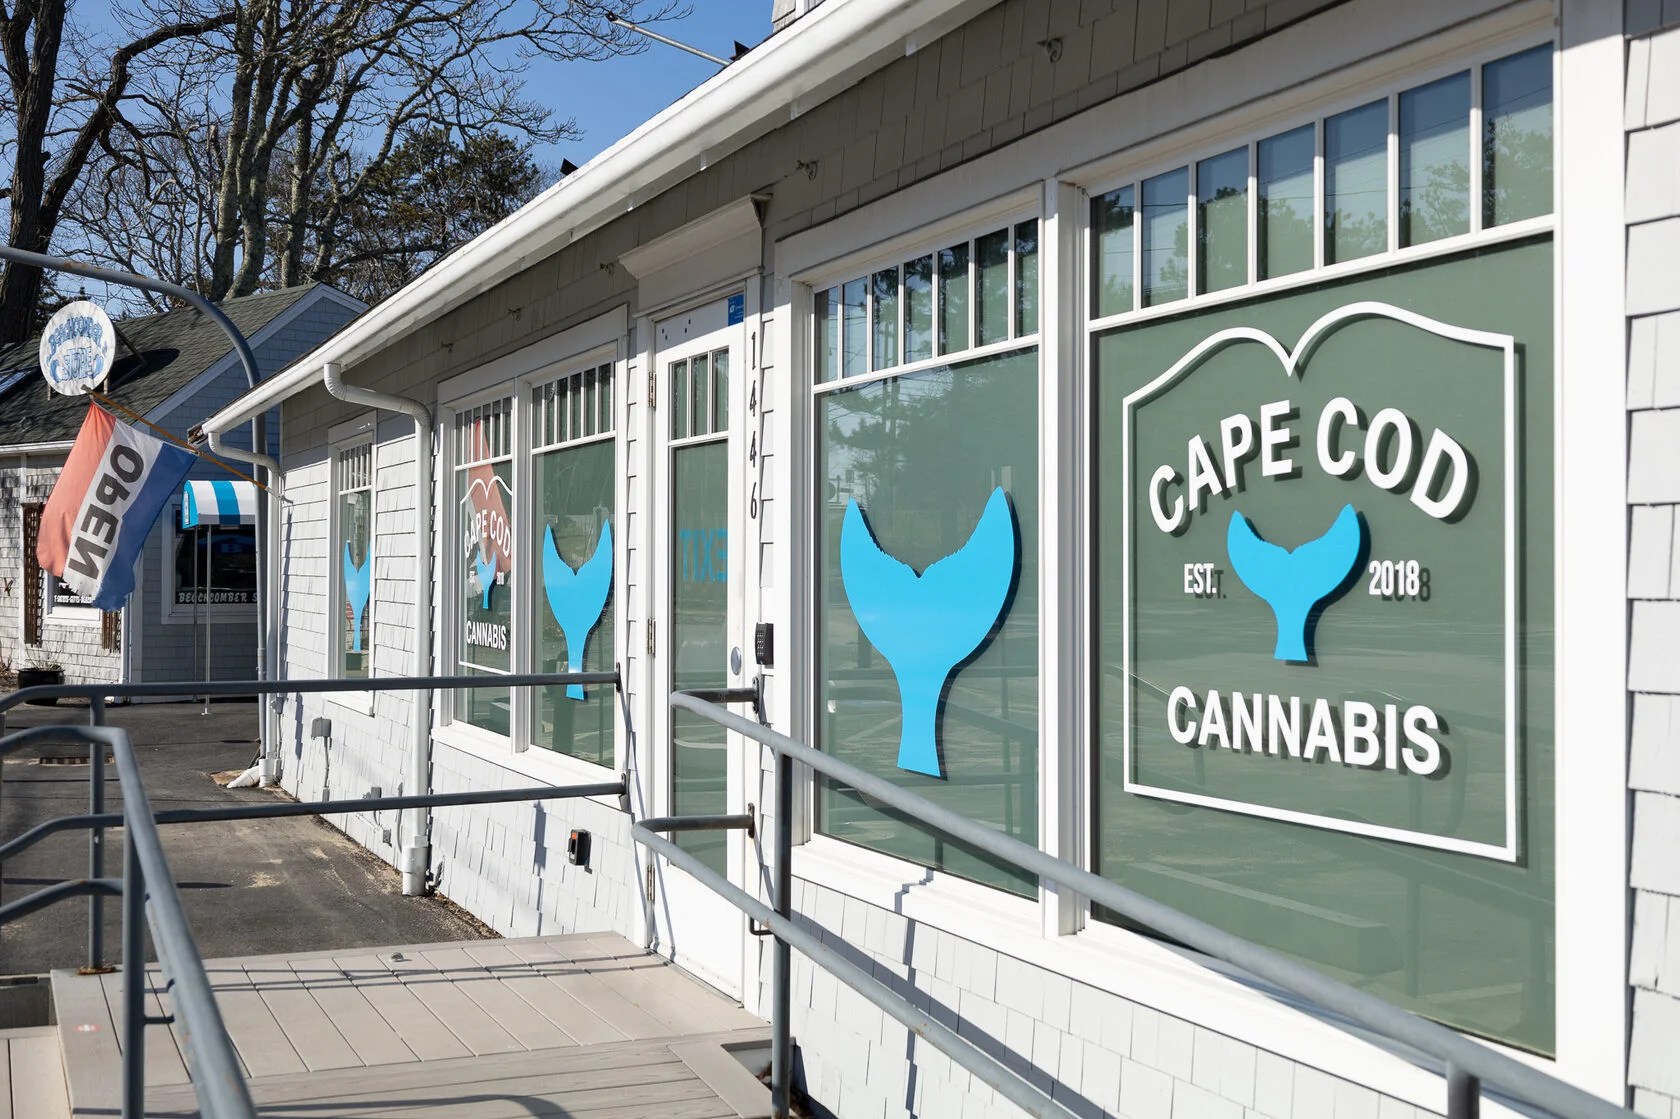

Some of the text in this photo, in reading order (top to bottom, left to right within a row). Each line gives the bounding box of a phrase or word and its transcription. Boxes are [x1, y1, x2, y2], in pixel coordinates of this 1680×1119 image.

[749, 331, 757, 519] 1446
[1149, 397, 1468, 533] CAPE COD
[464, 509, 511, 558] CAPE COD
[1184, 563, 1217, 594] EST.
[1368, 560, 1420, 596] 2018
[466, 620, 507, 651] CANNABIS
[1167, 685, 1441, 775] CANNABIS
